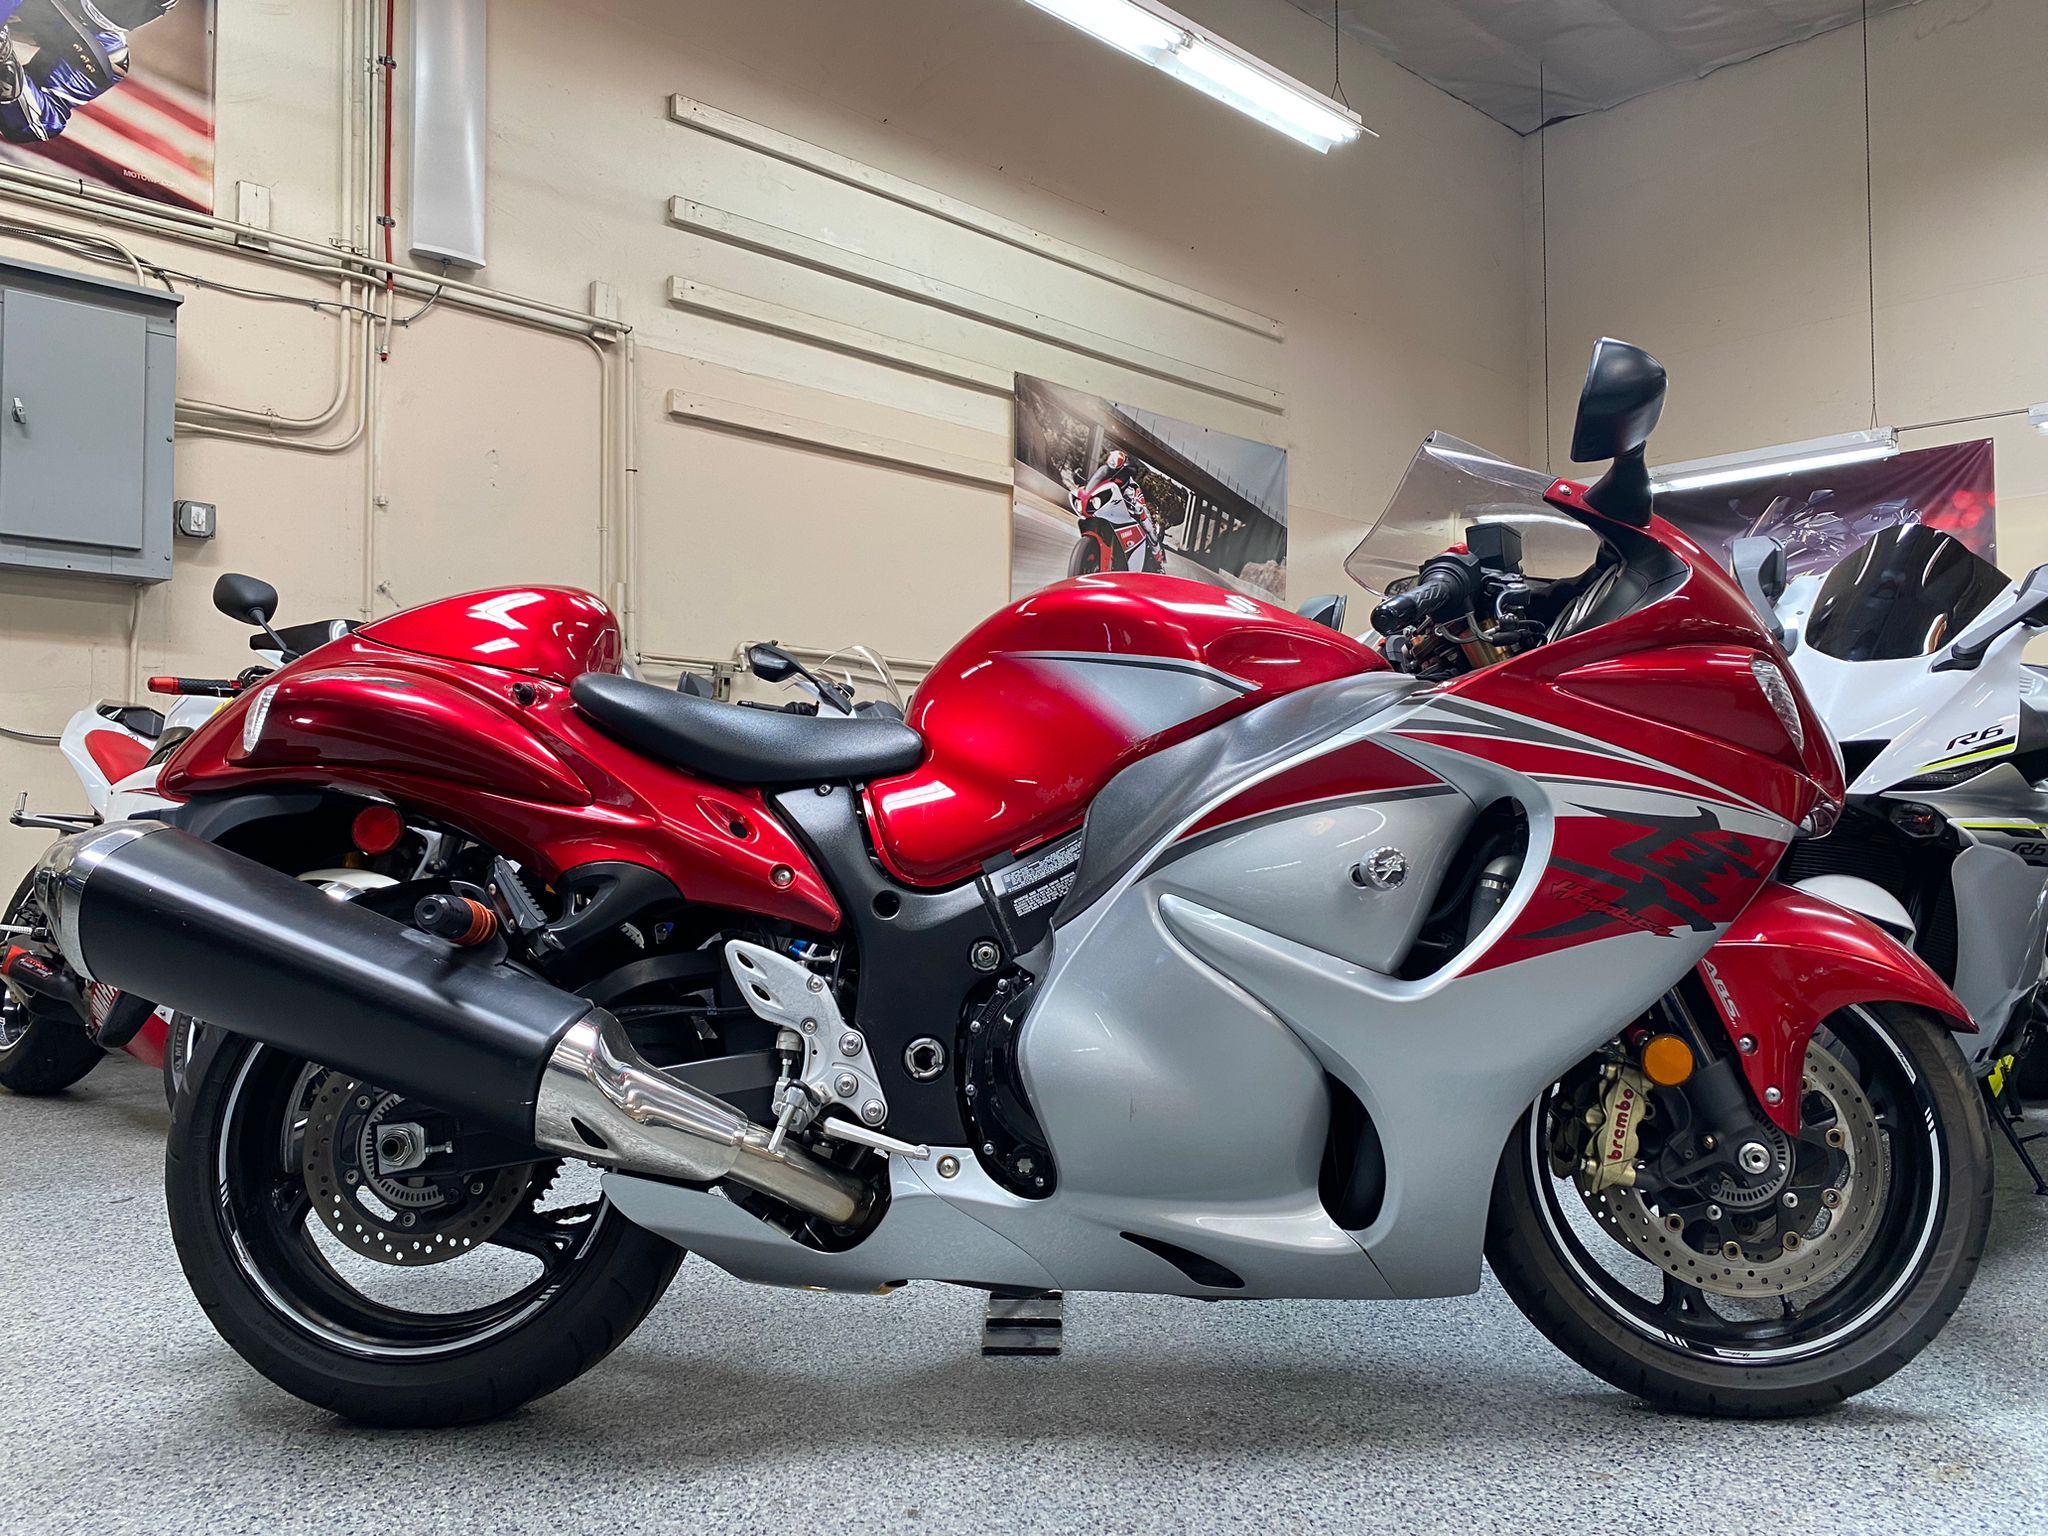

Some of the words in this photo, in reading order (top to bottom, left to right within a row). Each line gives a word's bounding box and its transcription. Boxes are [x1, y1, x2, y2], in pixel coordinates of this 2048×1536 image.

[1946, 723, 2004, 751] R6
[1551, 878, 1681, 939] Hayabusa
[1702, 957, 1741, 1019] ABS
[1607, 1087, 1635, 1161] brembo
